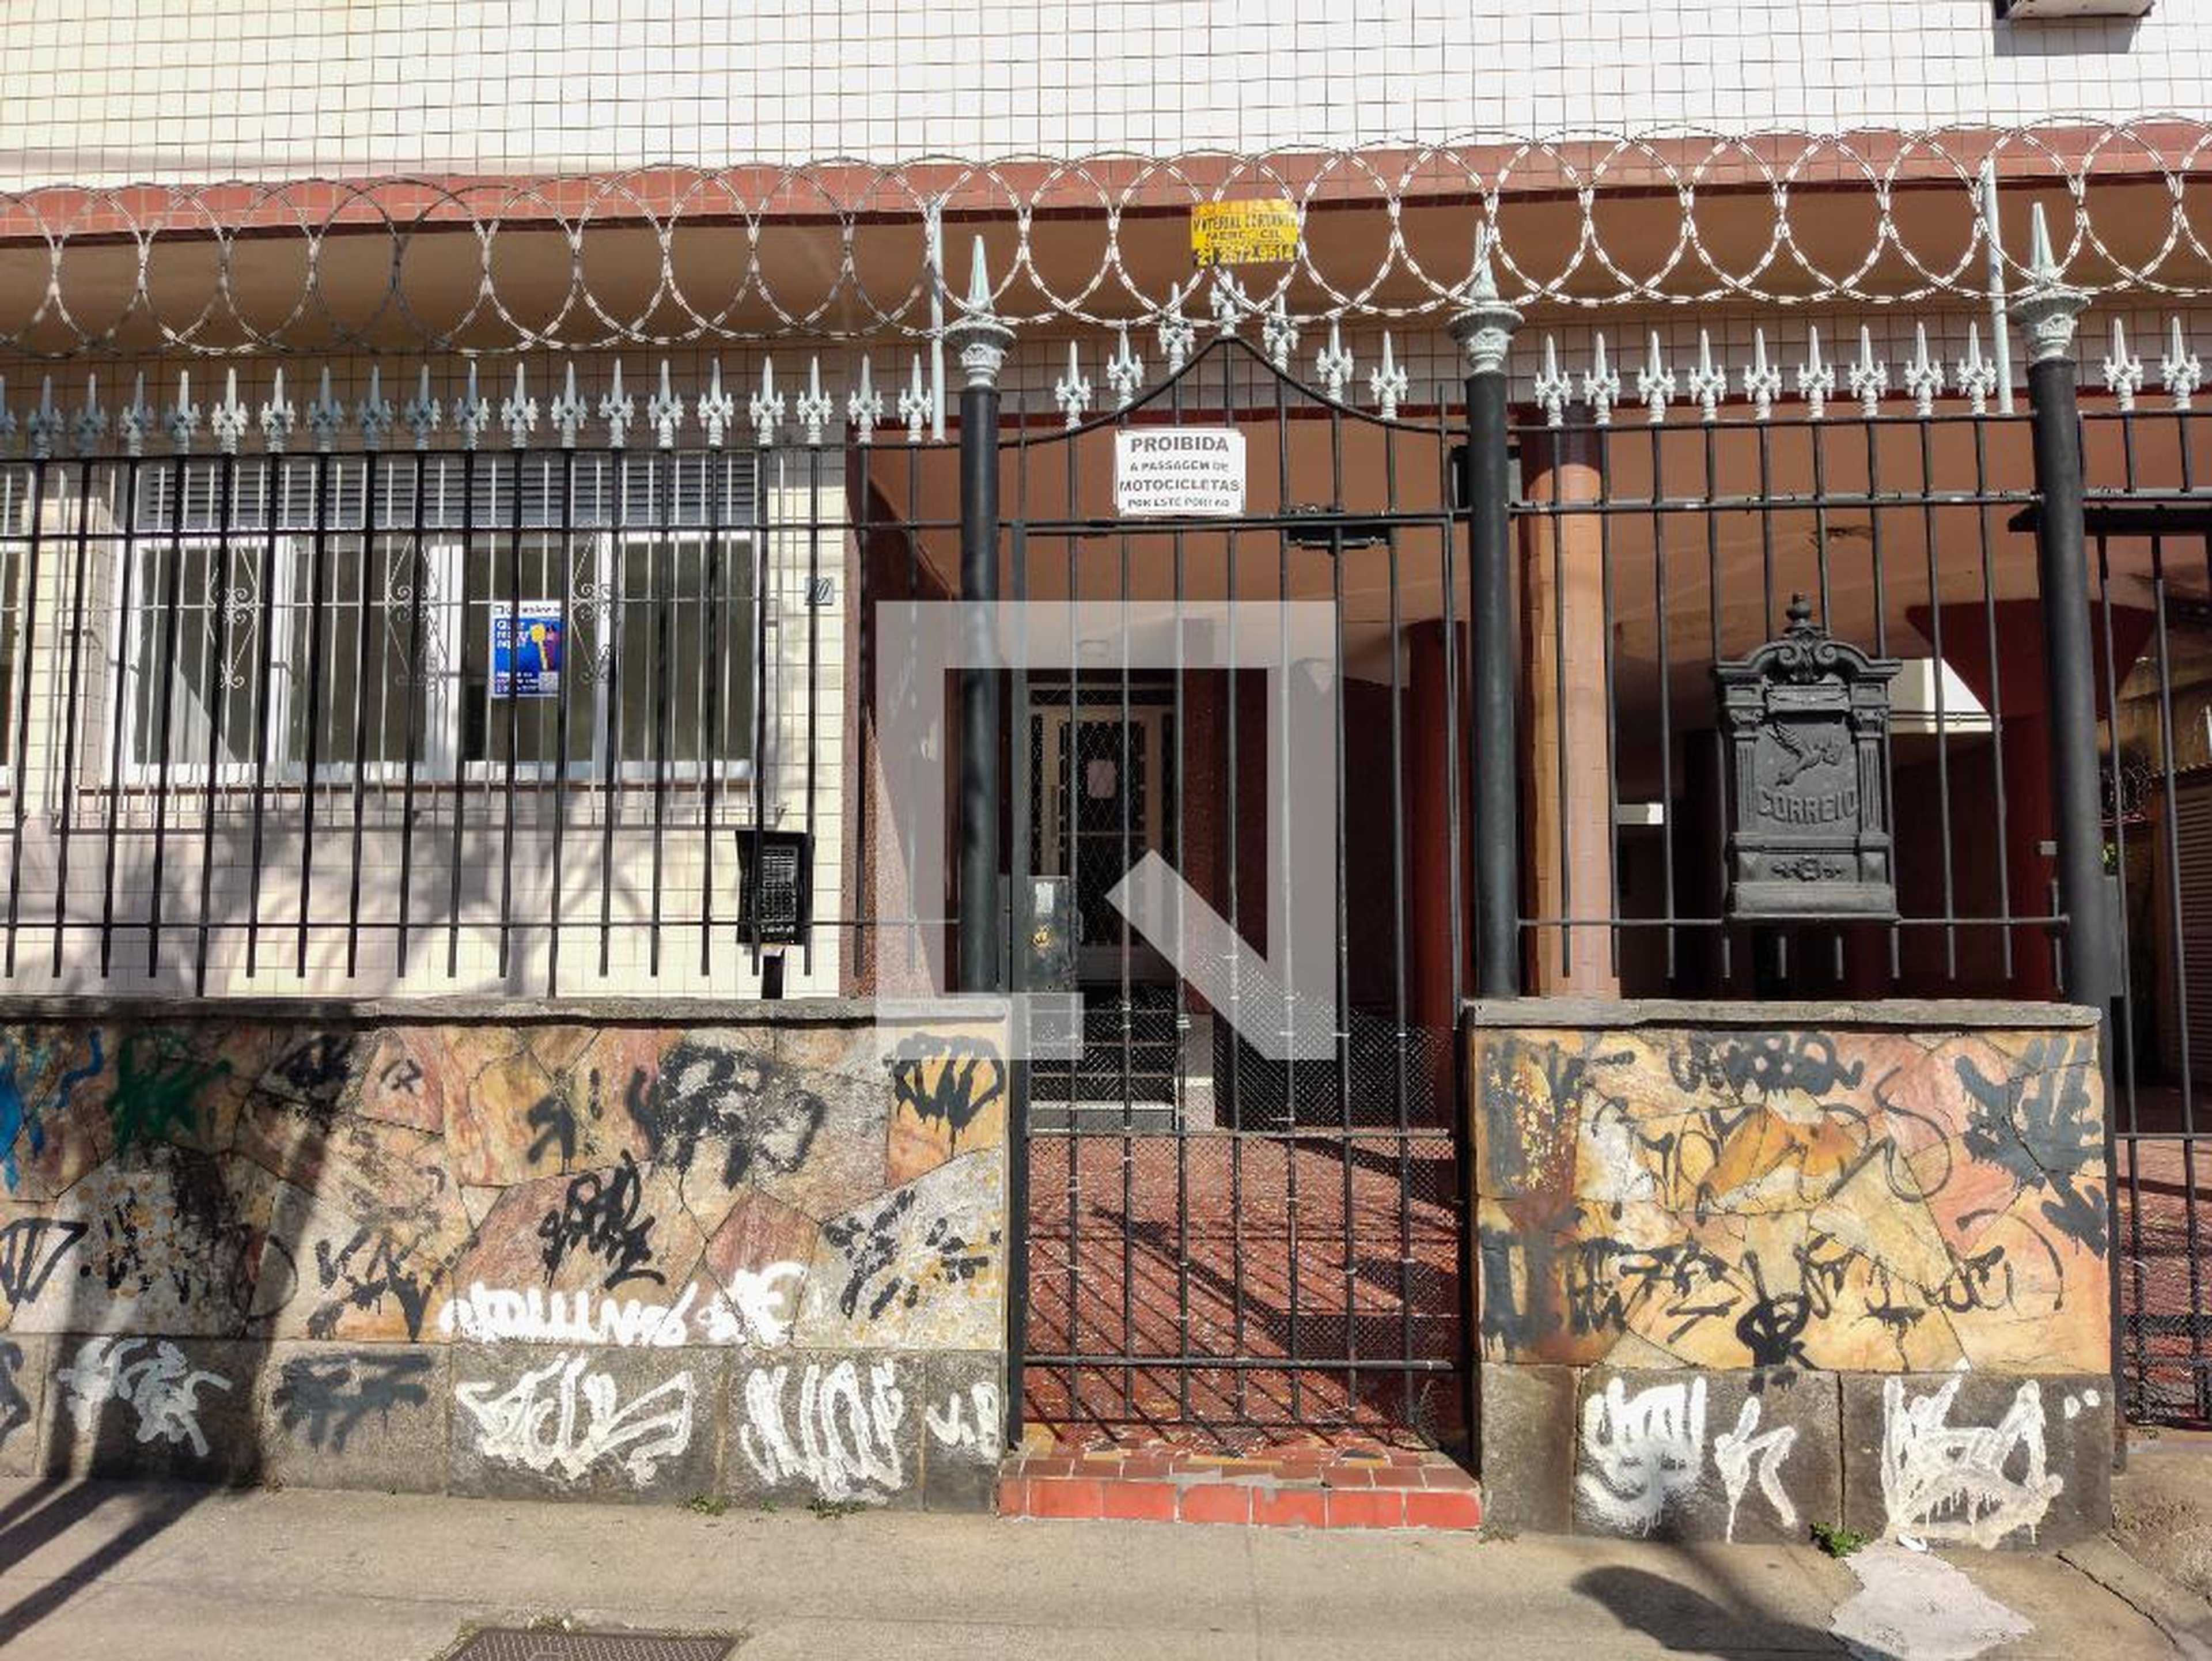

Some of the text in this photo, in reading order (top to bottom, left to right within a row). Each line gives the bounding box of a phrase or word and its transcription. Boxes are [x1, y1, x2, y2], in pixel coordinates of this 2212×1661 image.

[1131, 436, 1229, 452] PROIBIDA
[1130, 460, 1229, 471] A PASSAGEM DE
[1119, 478, 1240, 491] MOTOCICLETAS
[1757, 790, 1859, 824] CORREIO
